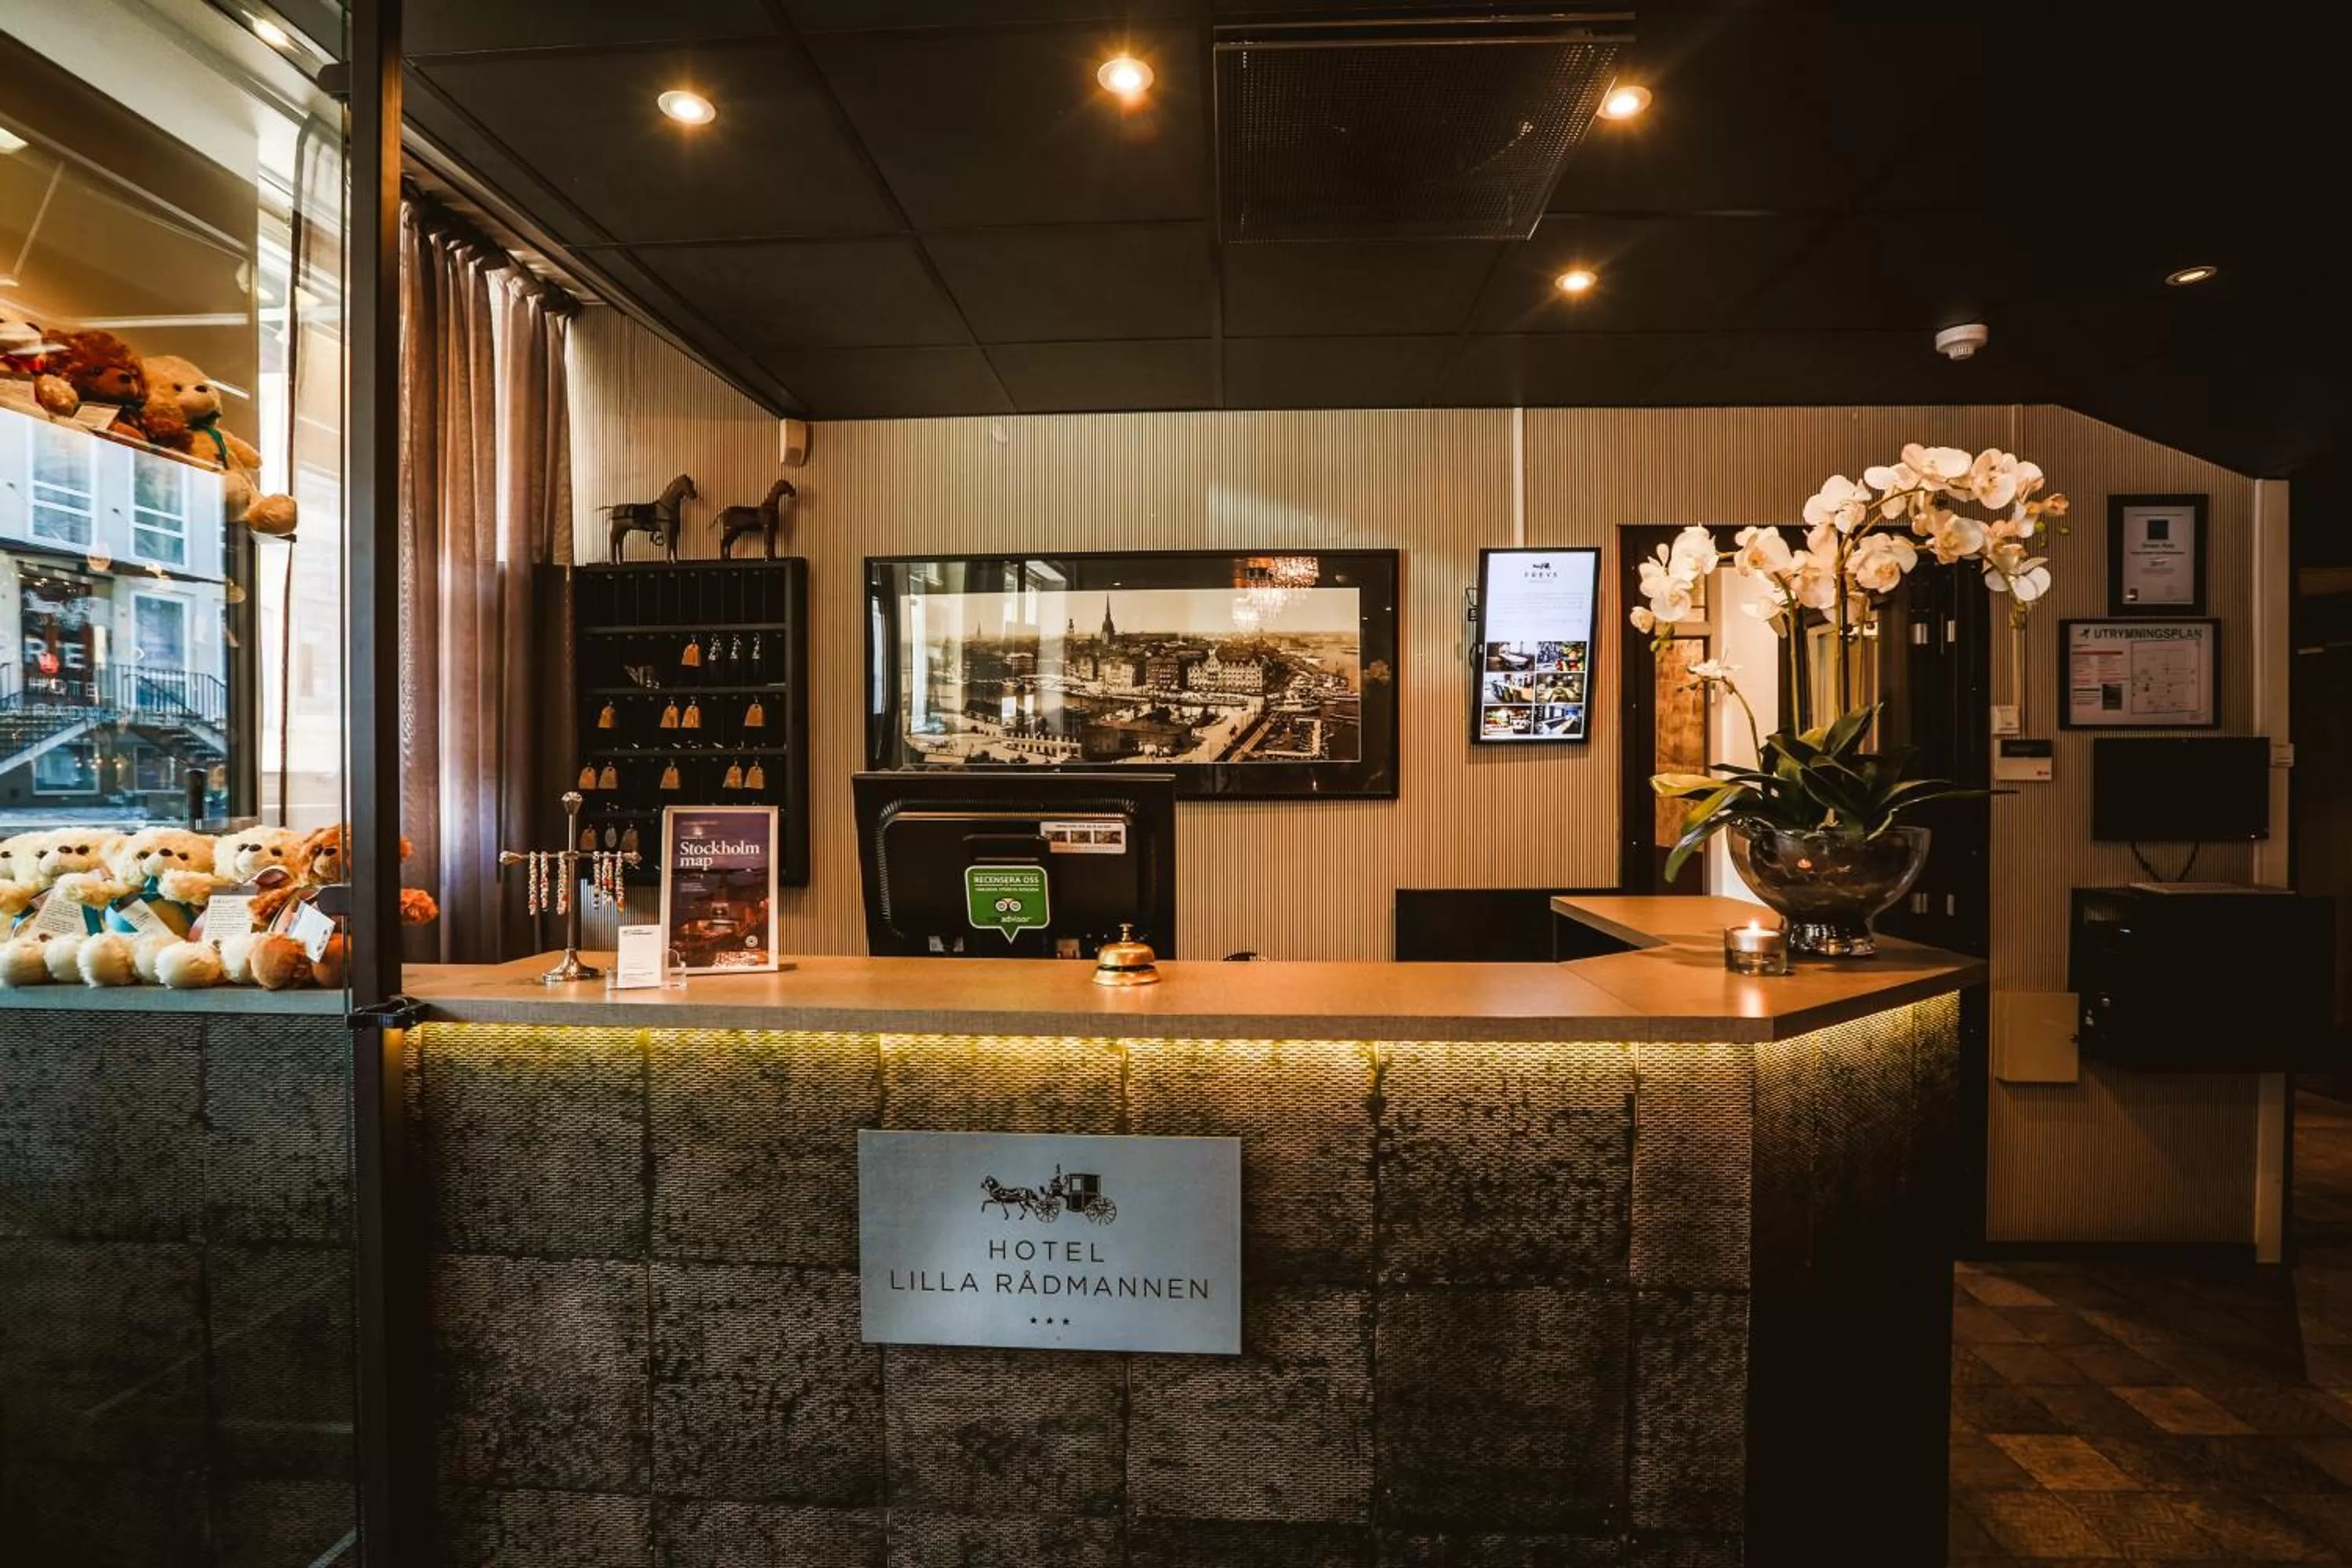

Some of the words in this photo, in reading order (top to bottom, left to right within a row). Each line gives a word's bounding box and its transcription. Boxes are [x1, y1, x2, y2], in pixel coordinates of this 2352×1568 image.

[2094, 627, 2203, 640] UTRYMNINGSPLAN
[680, 840, 760, 855] Stockholm
[680, 856, 713, 871] map
[989, 1240, 1105, 1263] HOTEL
[890, 1269, 979, 1293] LILLA
[996, 1269, 1209, 1299] RÅDMANNEN
